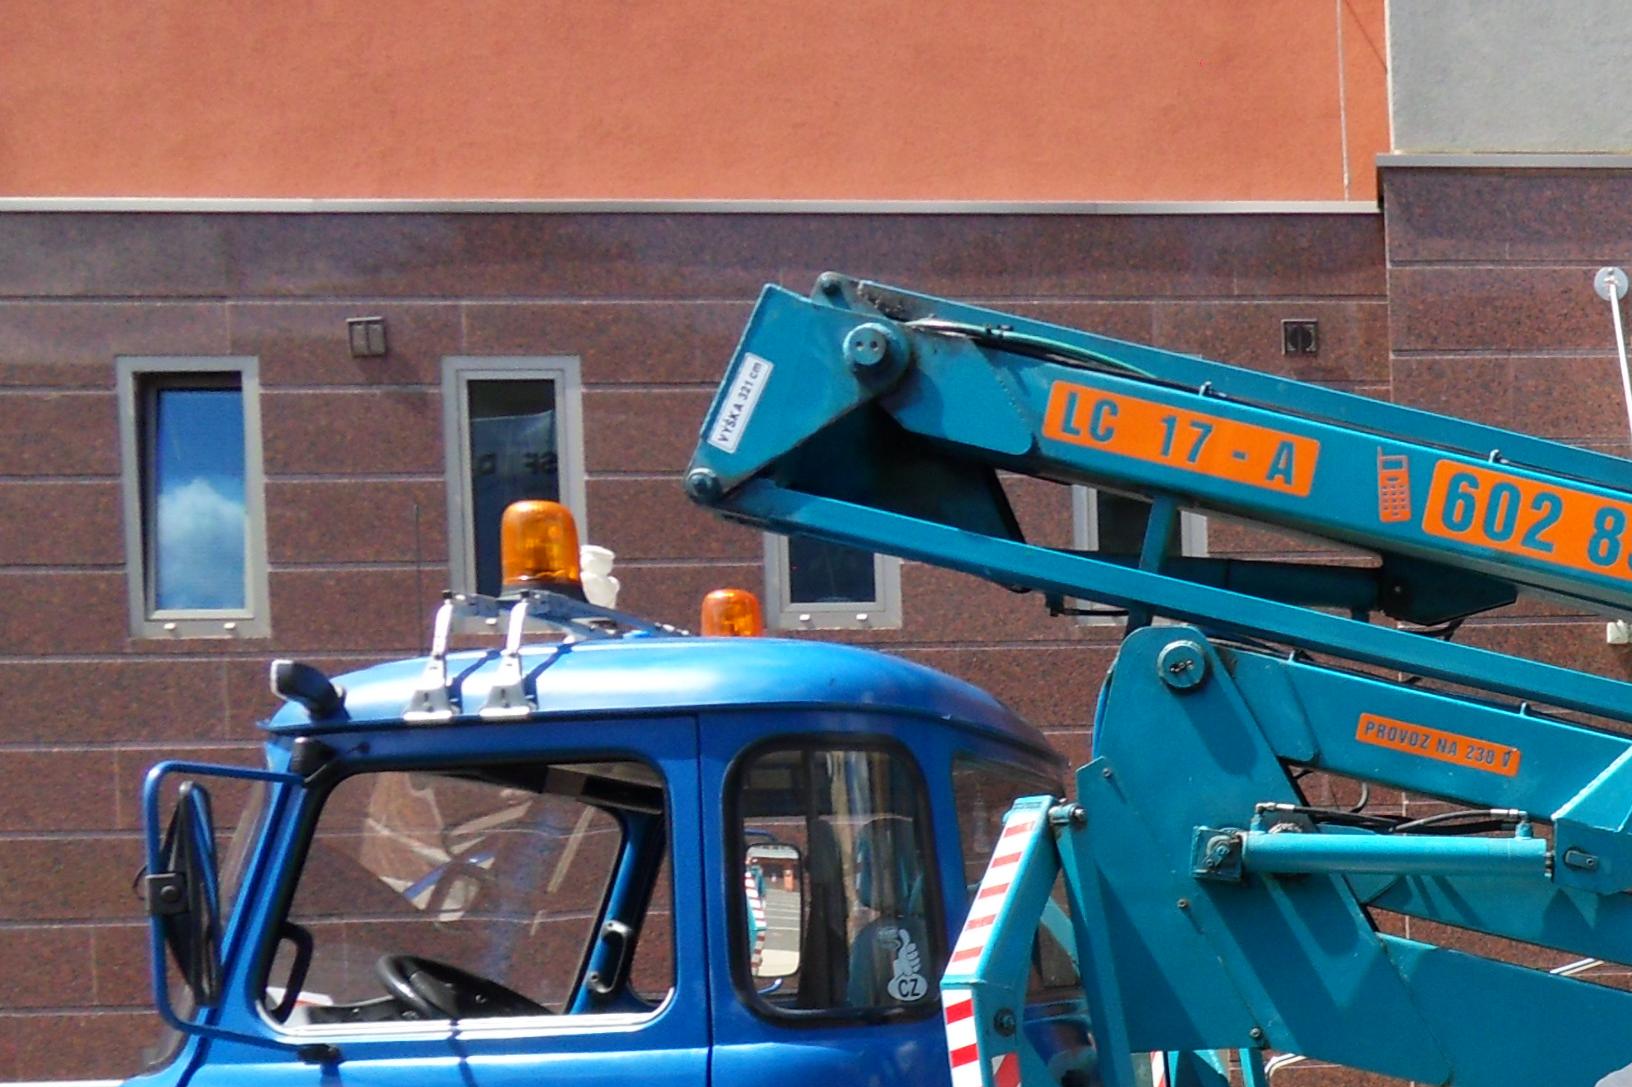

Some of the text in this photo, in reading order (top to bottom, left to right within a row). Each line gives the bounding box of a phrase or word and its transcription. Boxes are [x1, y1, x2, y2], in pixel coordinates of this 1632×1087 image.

[738, 381, 754, 401] 321
[749, 362, 763, 379] cm
[1062, 392, 1119, 443] LC
[1161, 415, 1216, 464] 17
[1265, 440, 1296, 487] A
[1441, 471, 1563, 554] 602
[1364, 720, 1433, 749] PROVOZ
[1435, 737, 1458, 757] NA
[1465, 744, 1496, 765] 230
[898, 978, 921, 998] CZ
